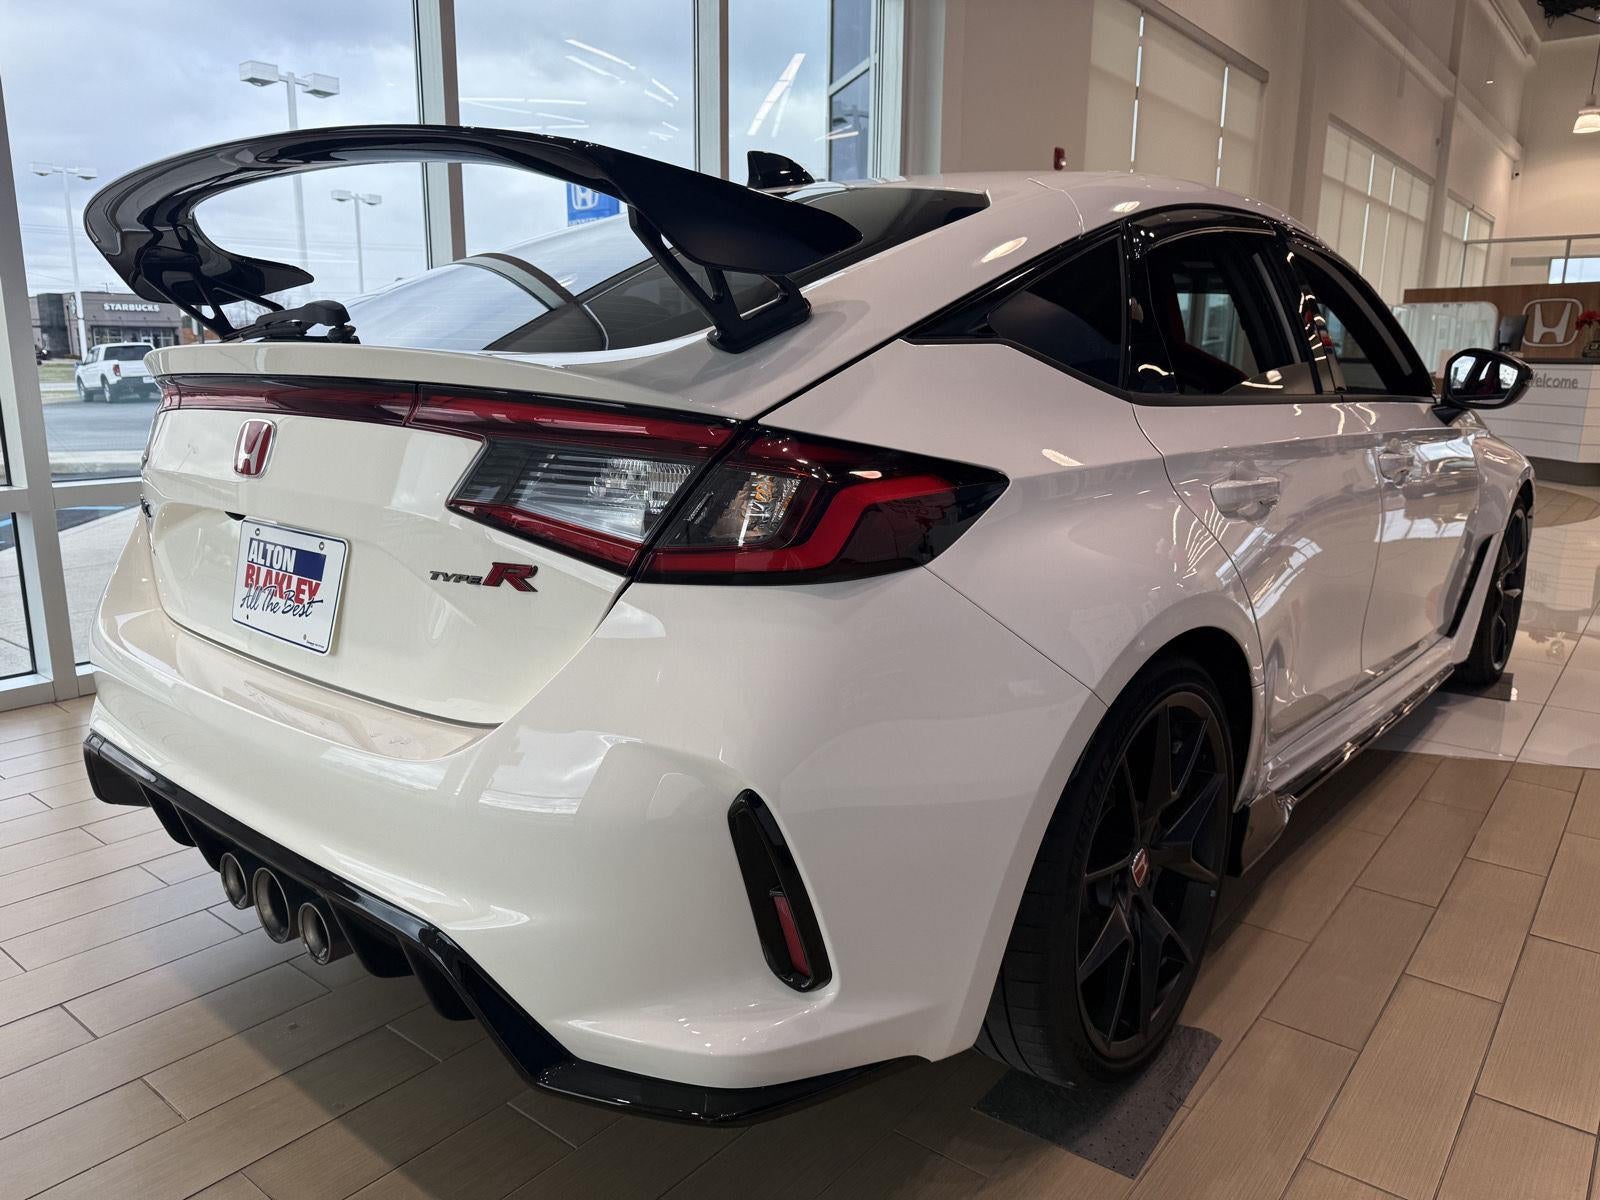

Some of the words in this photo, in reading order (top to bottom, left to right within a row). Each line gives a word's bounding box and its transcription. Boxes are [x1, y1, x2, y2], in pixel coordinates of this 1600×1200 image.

[103, 303, 160, 312] STARBUCKS
[248, 539, 297, 573] ALTON
[244, 563, 321, 605] BLAKLEY
[429, 570, 483, 586] TYPE
[482, 562, 539, 592] R
[240, 583, 264, 611] All
[262, 585, 280, 614] The
[281, 590, 324, 618] Best
